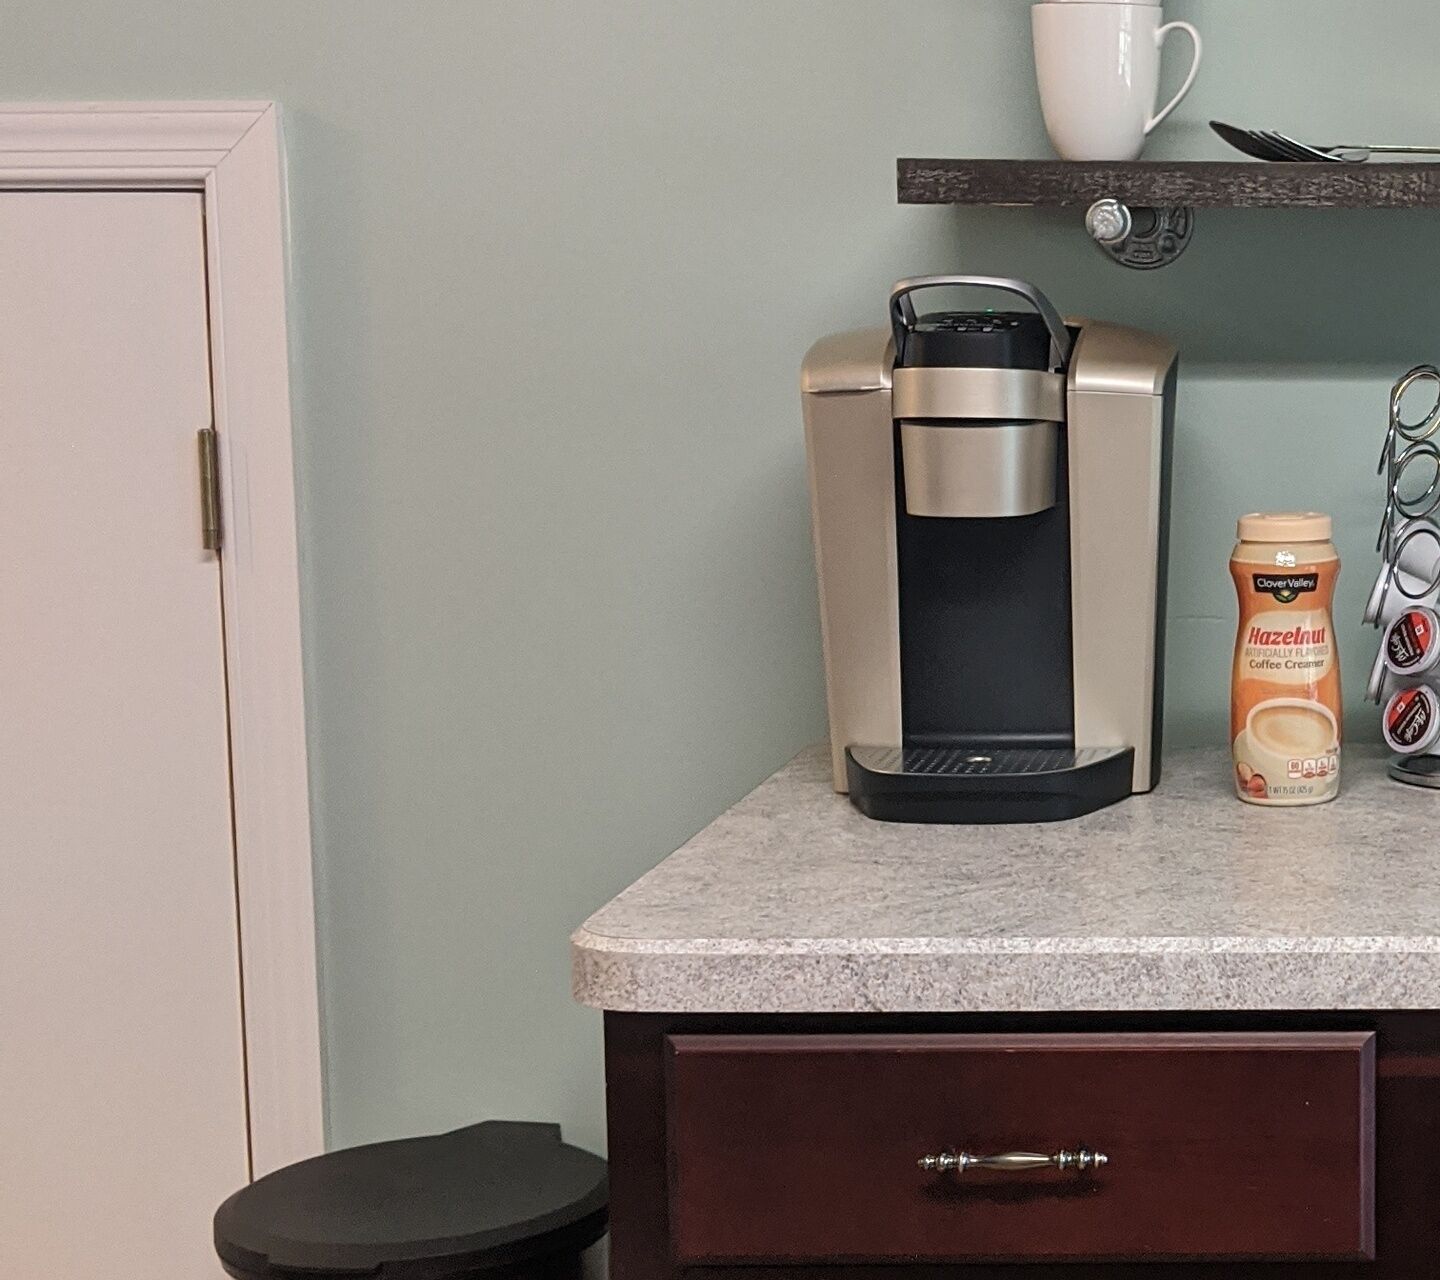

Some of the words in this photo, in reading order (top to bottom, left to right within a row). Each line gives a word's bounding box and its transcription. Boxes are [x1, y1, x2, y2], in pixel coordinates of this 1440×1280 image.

[1257, 577, 1287, 588] Clover
[1287, 577, 1315, 588] Valley
[1247, 626, 1325, 645] Hazelnut
[1245, 647, 1293, 657] ARTIFICIALLY
[1249, 659, 1282, 669] Coffee
[1284, 659, 1325, 669] Creamer
